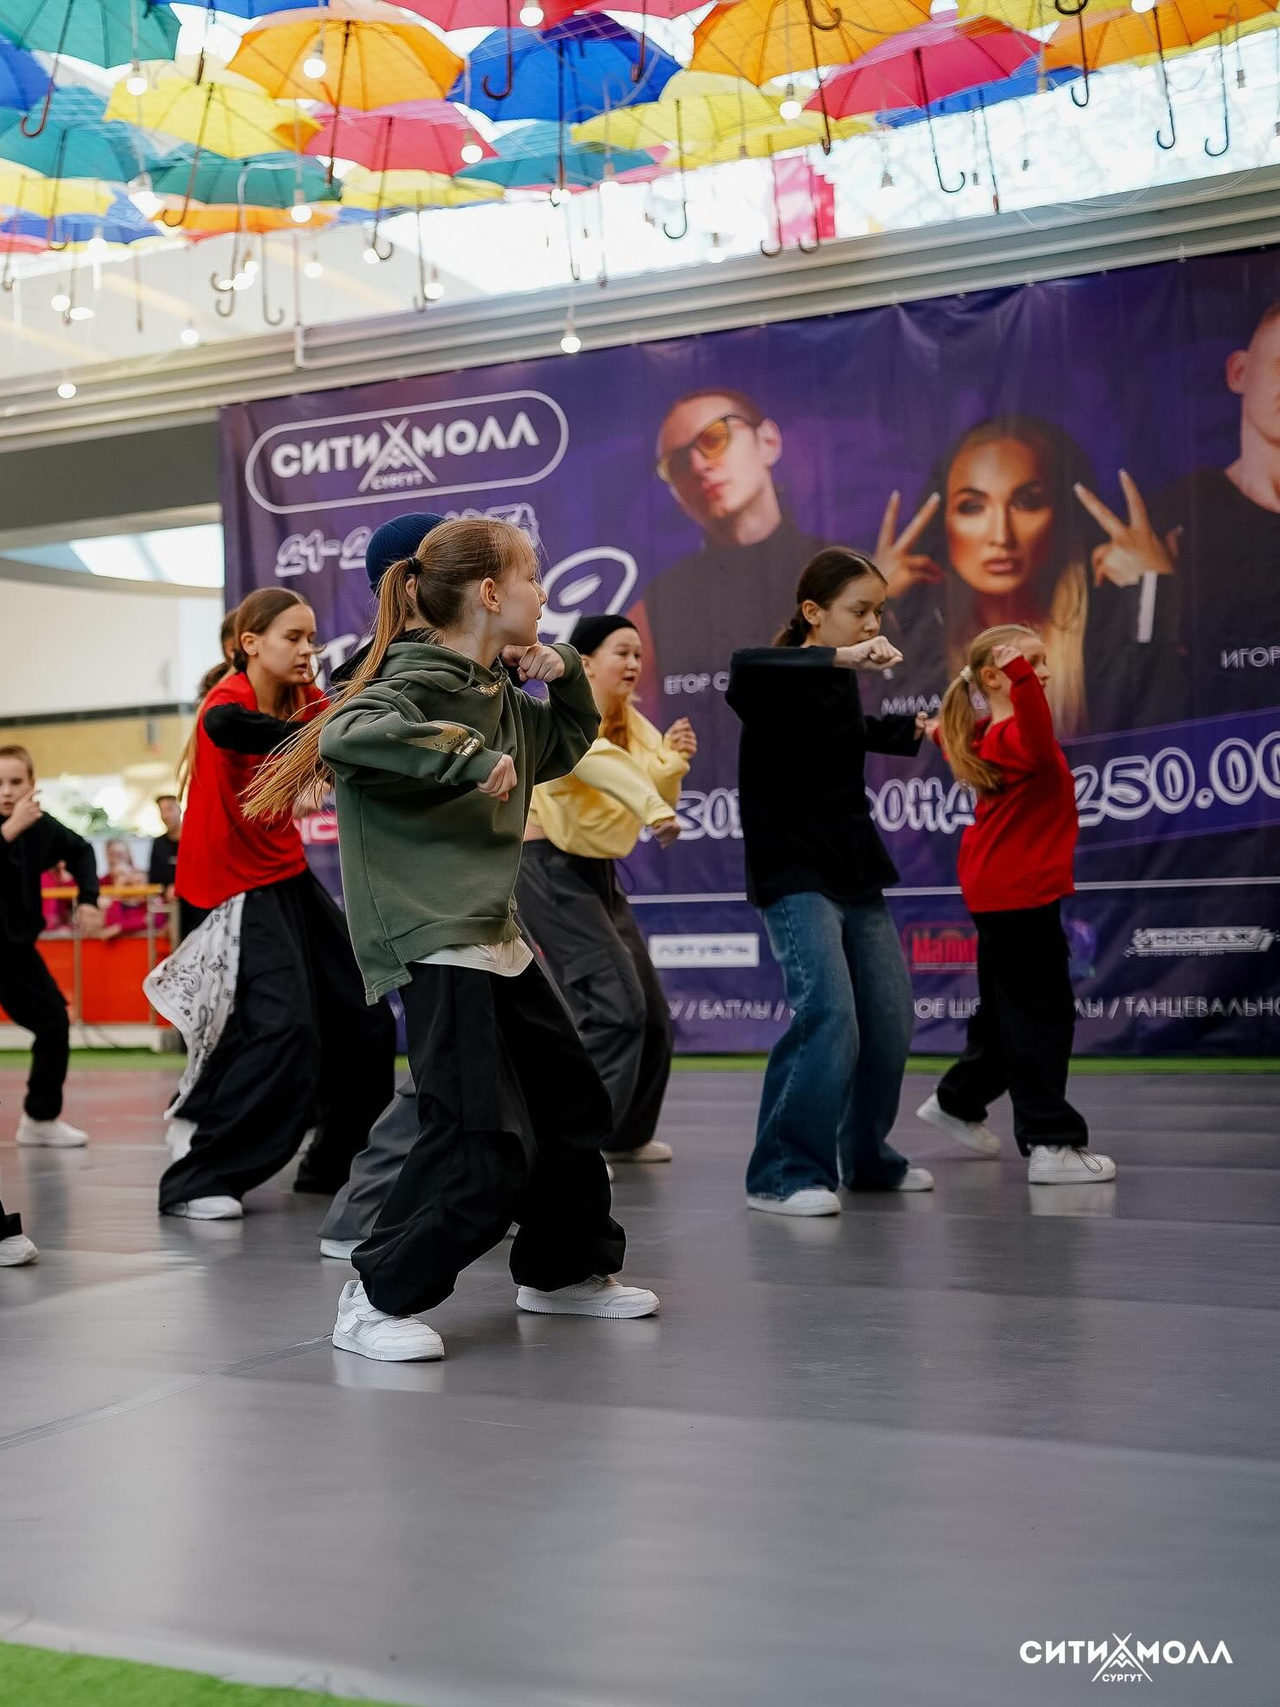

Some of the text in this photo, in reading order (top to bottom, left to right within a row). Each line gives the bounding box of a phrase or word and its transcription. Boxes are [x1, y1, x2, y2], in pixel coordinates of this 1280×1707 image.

[271, 411, 541, 478] СИТИ МОЛЛ
[274, 525, 371, 577] 21-2
[865, 776, 977, 834] ОНД
